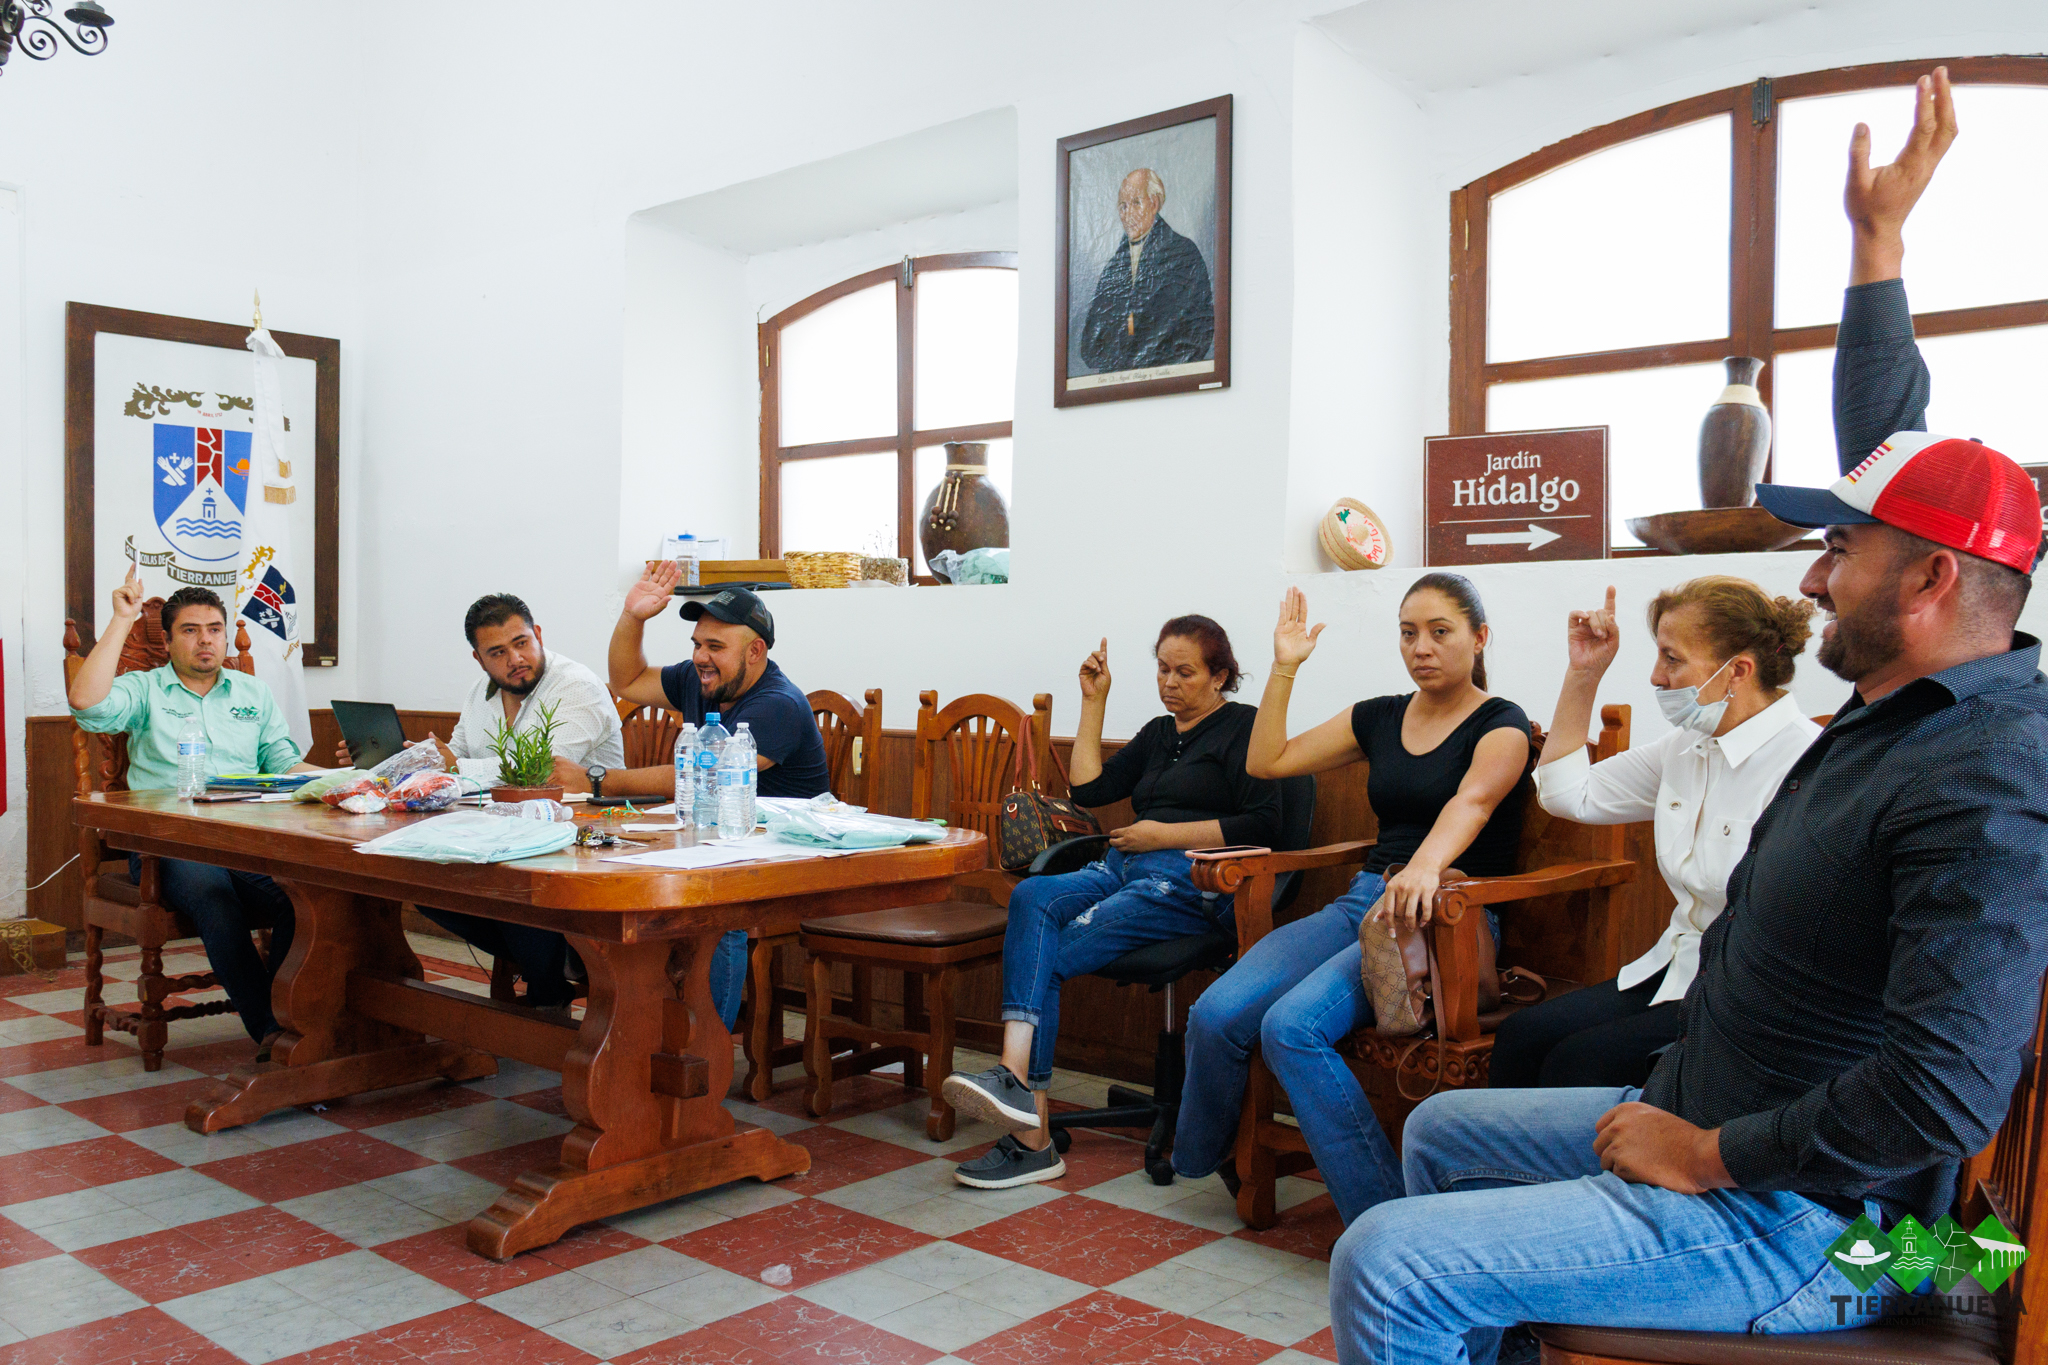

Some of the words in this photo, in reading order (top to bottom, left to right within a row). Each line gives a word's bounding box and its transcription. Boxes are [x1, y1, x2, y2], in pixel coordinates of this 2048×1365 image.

[1484, 451, 1541, 476] Jardín
[1452, 473, 1580, 513] Hidalgo
[158, 555, 166, 565] DE
[168, 566, 236, 584] TIERRANUE
